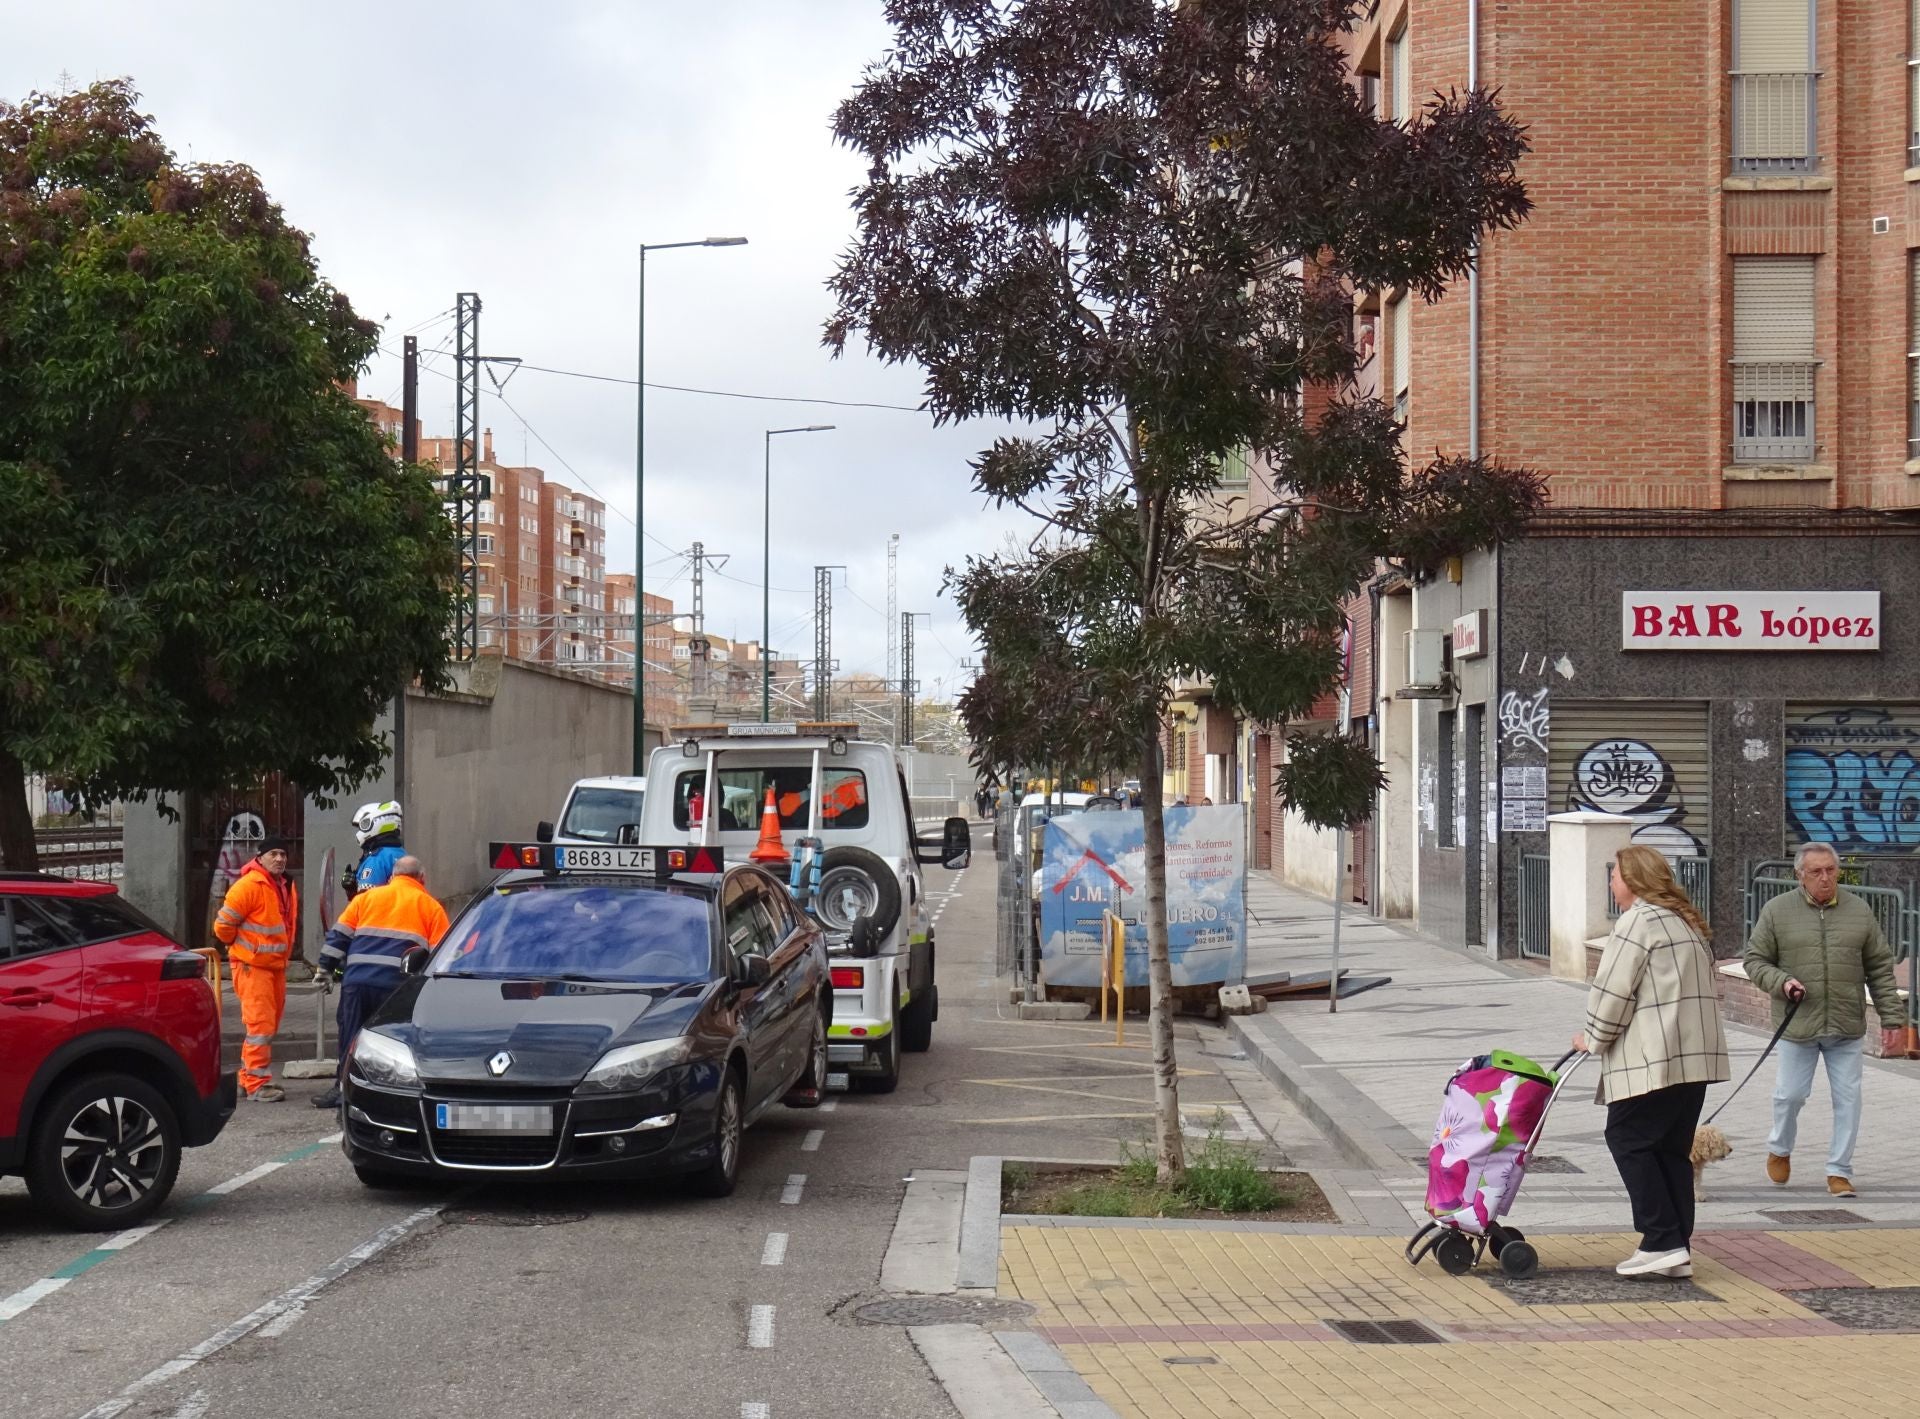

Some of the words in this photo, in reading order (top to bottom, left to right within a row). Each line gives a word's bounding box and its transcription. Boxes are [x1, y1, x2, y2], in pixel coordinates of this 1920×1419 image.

[1632, 604, 1742, 637] BAR
[1760, 606, 1874, 644] López
[754, 726, 793, 735] MUNICIPAL
[1196, 839, 1233, 849] Reformas
[568, 850, 611, 867] 8683
[617, 851, 651, 868] LZF
[1223, 852, 1233, 862] de
[1179, 867, 1233, 880] Comunidades
[1070, 886, 1108, 902] J.M.
